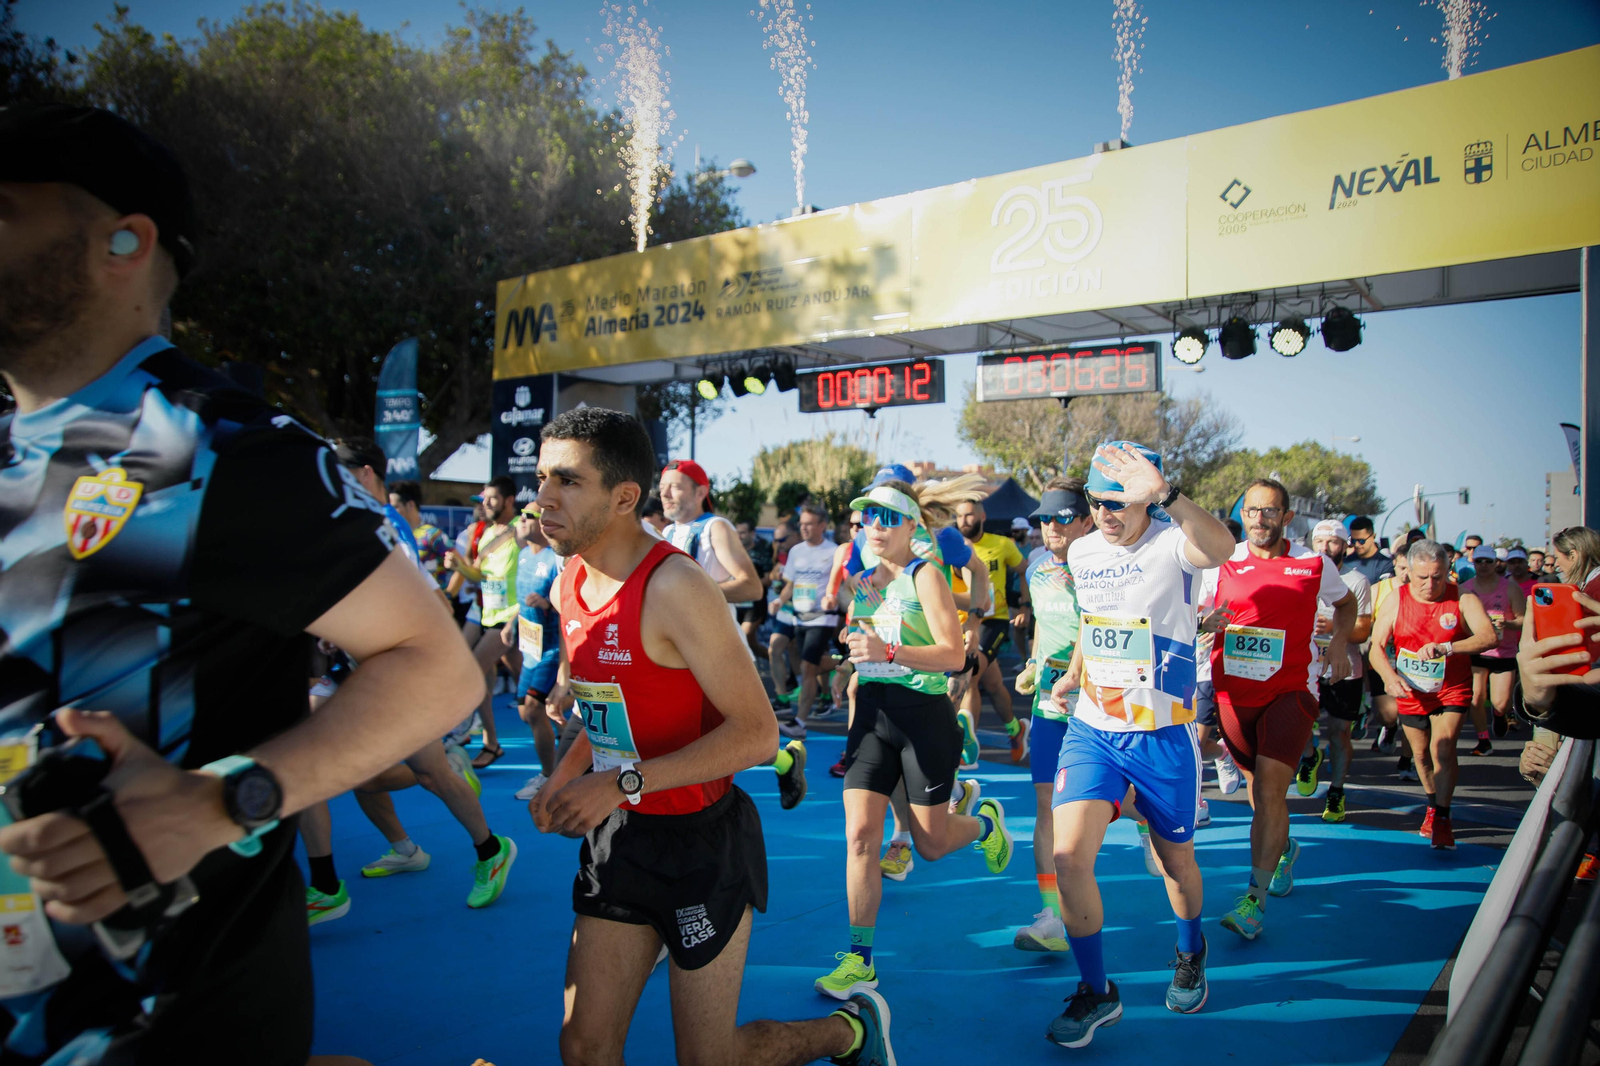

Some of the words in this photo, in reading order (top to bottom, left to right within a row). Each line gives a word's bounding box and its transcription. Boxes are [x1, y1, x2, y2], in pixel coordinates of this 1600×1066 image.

[1521, 147, 1594, 172] CIUDAD
[1218, 202, 1306, 225] COOPERACIÓN
[1336, 198, 1358, 210] 2020
[990, 171, 1104, 274] 25
[1218, 223, 1247, 237] 2005
[991, 265, 1103, 300] EDICIÓN
[586, 291, 631, 312] Medio
[636, 278, 707, 302] Maratón
[715, 300, 761, 319] RAMÓN
[766, 296, 798, 312] RUIZ
[802, 284, 871, 307] ANDÚJAR
[584, 307, 650, 337] Almería
[653, 299, 705, 327] 2024
[817, 363, 931, 408] 00:00:12
[500, 406, 545, 427] cajamar
[115, 488, 131, 500] D
[1117, 575, 1145, 587] BAZA
[1091, 627, 1134, 651] 687
[1235, 635, 1271, 653] 826
[598, 650, 633, 662] SAYMA
[1402, 657, 1441, 674] 1557
[581, 700, 609, 735] 27
[678, 917, 712, 936] VERA
[697, 911, 708, 920] DE
[682, 924, 717, 949] CASE
